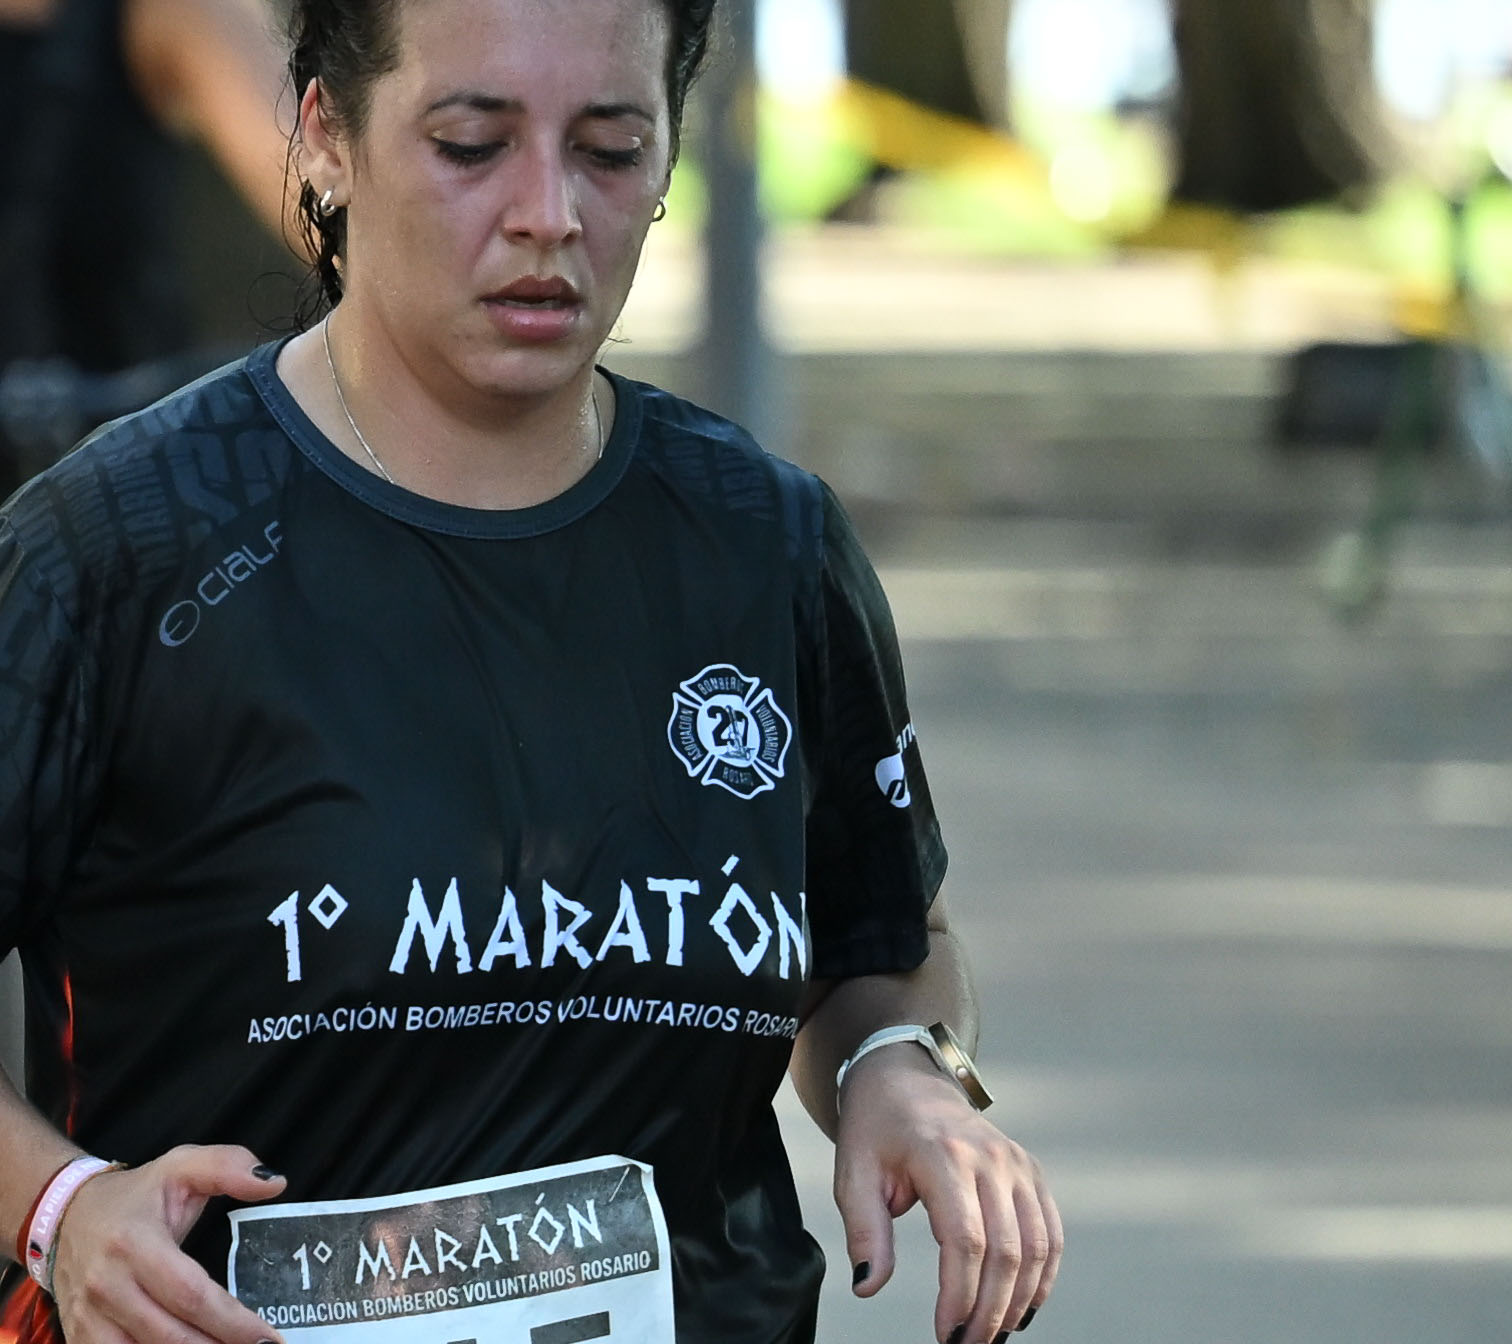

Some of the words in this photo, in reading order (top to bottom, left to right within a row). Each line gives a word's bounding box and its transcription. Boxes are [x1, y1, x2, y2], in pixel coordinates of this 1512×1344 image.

[388, 854, 807, 981] MARATÓN
[247, 1001, 398, 1044] ASOCIACIÓN
[404, 1000, 552, 1032] BOMBEROS
[557, 995, 741, 1033] VOLUNTARIOS
[354, 1192, 603, 1285] MARATÓN
[363, 1287, 460, 1317] BOMBEROS
[462, 1265, 577, 1303] VOLUNTARIOS
[580, 1250, 651, 1281] ROSARIO
